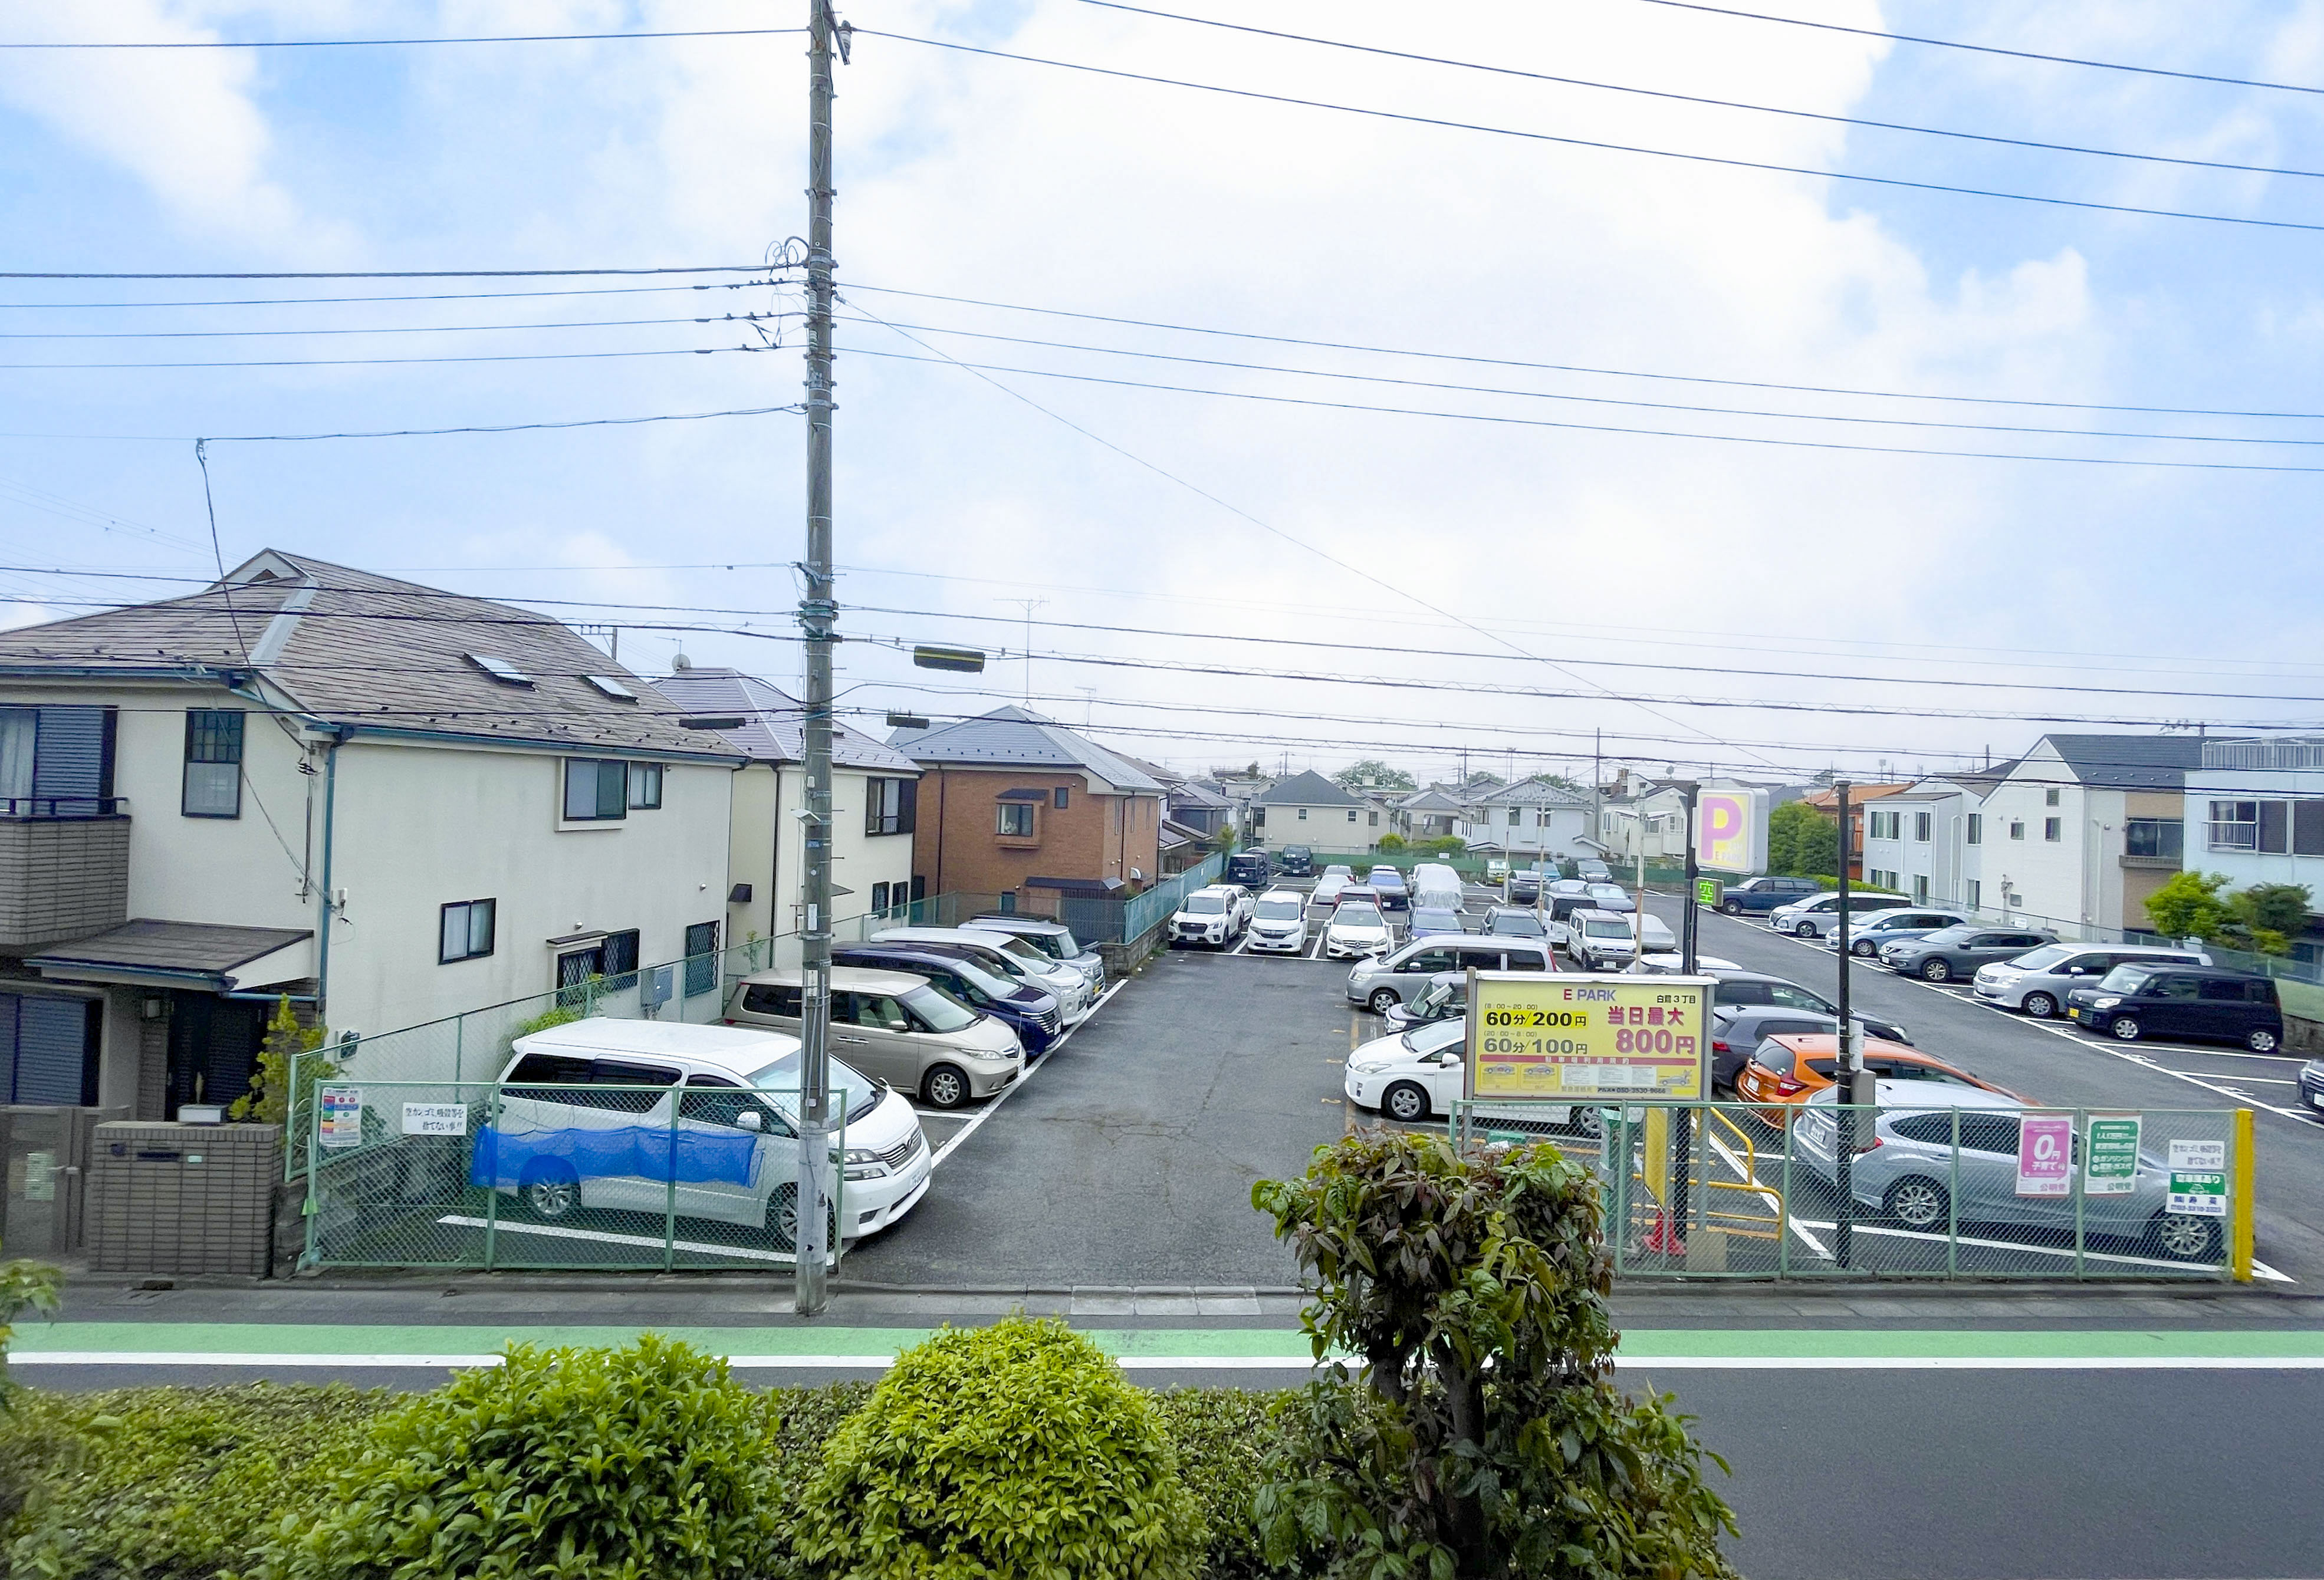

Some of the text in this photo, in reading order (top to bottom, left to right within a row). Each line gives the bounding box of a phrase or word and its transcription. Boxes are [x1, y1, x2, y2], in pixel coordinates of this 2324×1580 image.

[1701, 797, 1743, 861] P
[1698, 880, 1714, 903] 空
[1563, 989, 1616, 1002] E PARK
[1485, 1011, 1587, 1026] 60分/200円
[1608, 1005, 1684, 1026] 当日最大
[1484, 1038, 1587, 1055] 60分/100円
[1615, 1028, 1696, 1055] 800円
[2034, 1134, 2061, 1161] 0円
